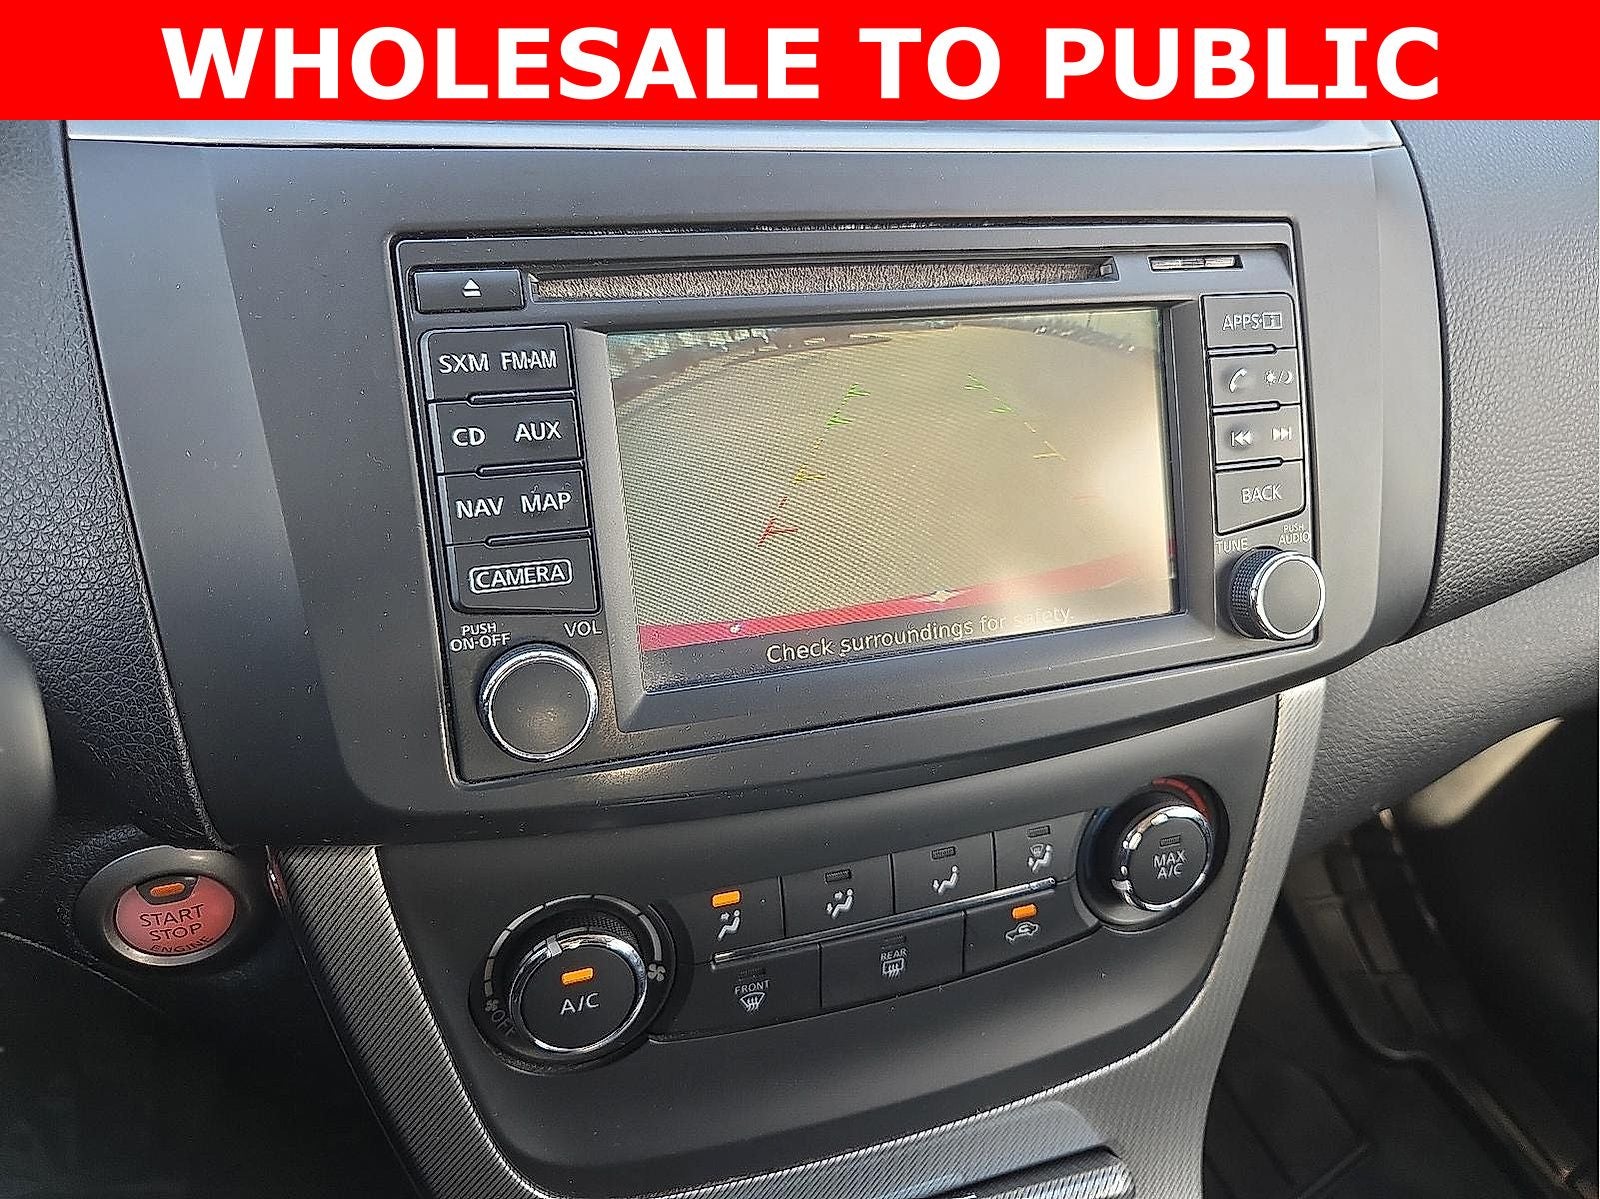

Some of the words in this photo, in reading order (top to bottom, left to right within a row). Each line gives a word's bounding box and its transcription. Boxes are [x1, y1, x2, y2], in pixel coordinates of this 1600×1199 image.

[439, 352, 490, 374] SXM
[452, 427, 487, 447] CD
[514, 421, 562, 442] AUX
[520, 491, 572, 514] MAP
[1241, 484, 1283, 504] BACK
[456, 497, 504, 519] NAV
[1283, 523, 1304, 533] PUSH
[1216, 538, 1249, 553] TUNE
[1278, 532, 1312, 546] AUDIO
[475, 564, 567, 589] CAMERA
[461, 622, 497, 635] PUSH
[564, 620, 603, 638] VOL
[766, 636, 834, 665] Check
[840, 619, 974, 655] surroundings
[980, 614, 1007, 633] for
[1153, 850, 1188, 868] MAX
[1157, 863, 1183, 880] A/C
[139, 903, 204, 927] START
[149, 922, 202, 941] STOP
[151, 935, 214, 952] ENGINE
[880, 948, 908, 961] REAR
[734, 979, 770, 995] FRONT
[560, 992, 600, 1016] A/C
